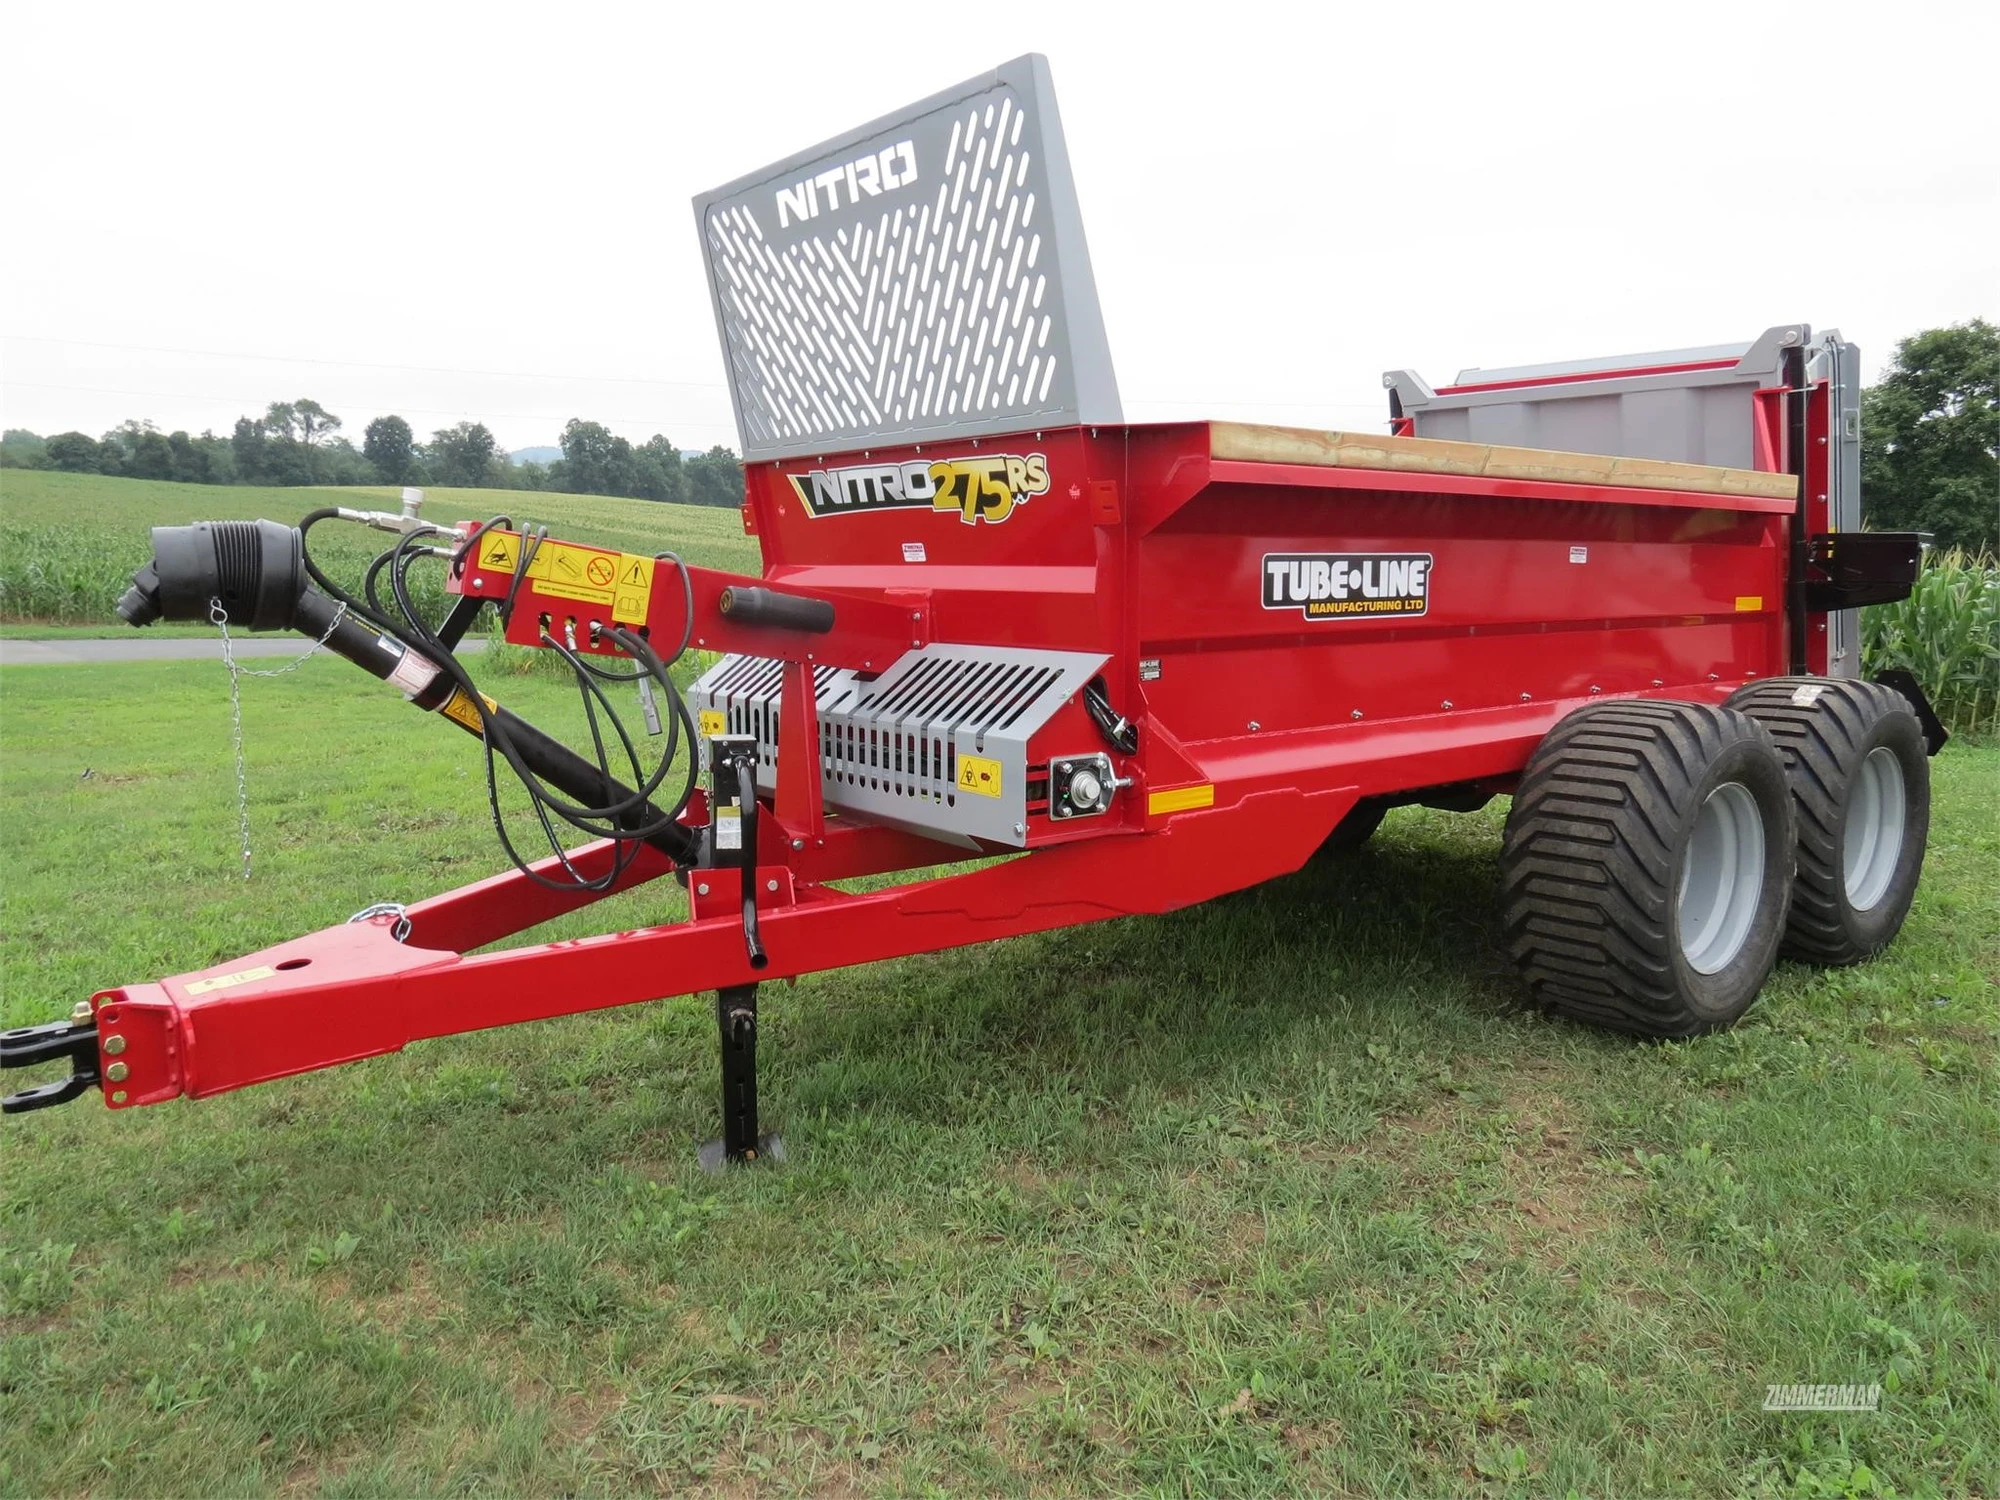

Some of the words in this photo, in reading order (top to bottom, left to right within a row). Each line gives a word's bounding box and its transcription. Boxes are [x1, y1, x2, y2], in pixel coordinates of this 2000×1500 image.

[775, 140, 918, 229] NITRO
[1309, 601, 1402, 614] MANUFACTURING
[1404, 599, 1424, 610] LTD
